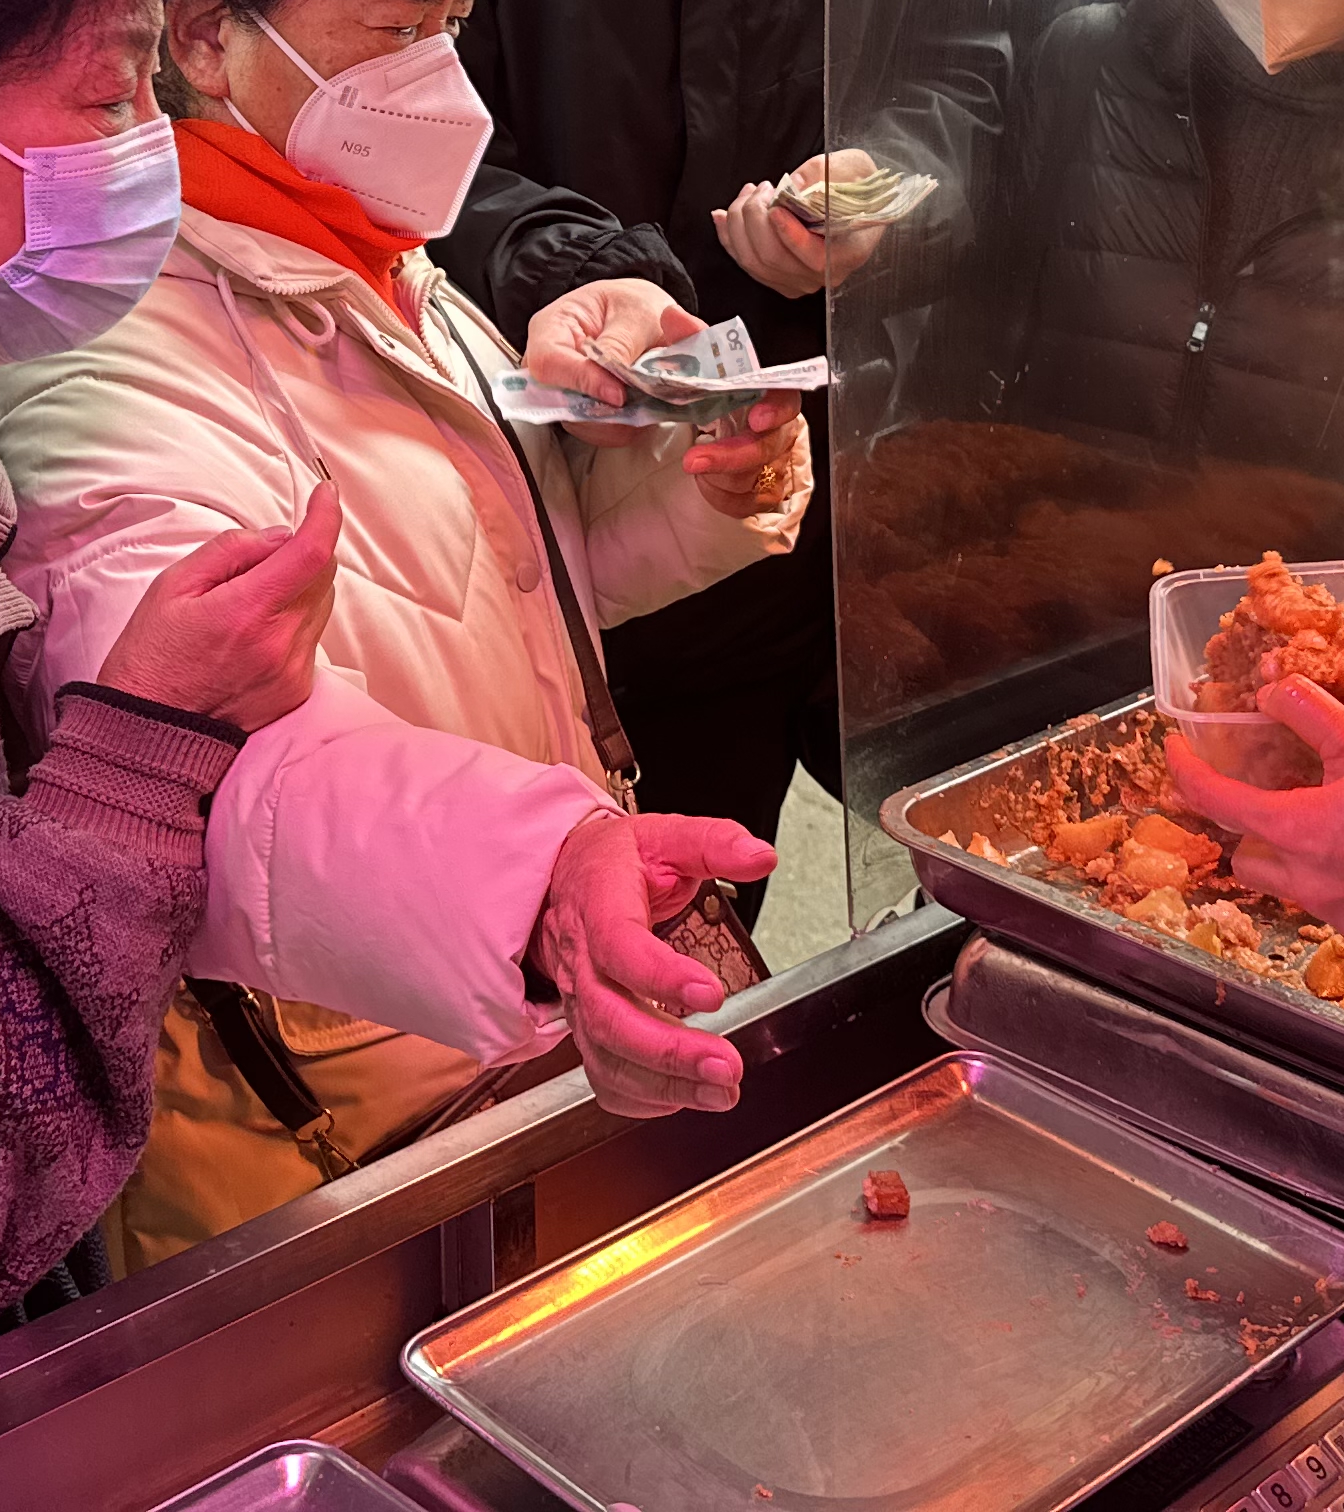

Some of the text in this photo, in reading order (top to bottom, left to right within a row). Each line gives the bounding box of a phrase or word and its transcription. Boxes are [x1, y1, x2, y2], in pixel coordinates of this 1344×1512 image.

[340, 140, 372, 158] N95
[726, 328, 744, 352] 50
[1305, 1455, 1327, 1480] 9
[1270, 1482, 1294, 1509] 8
